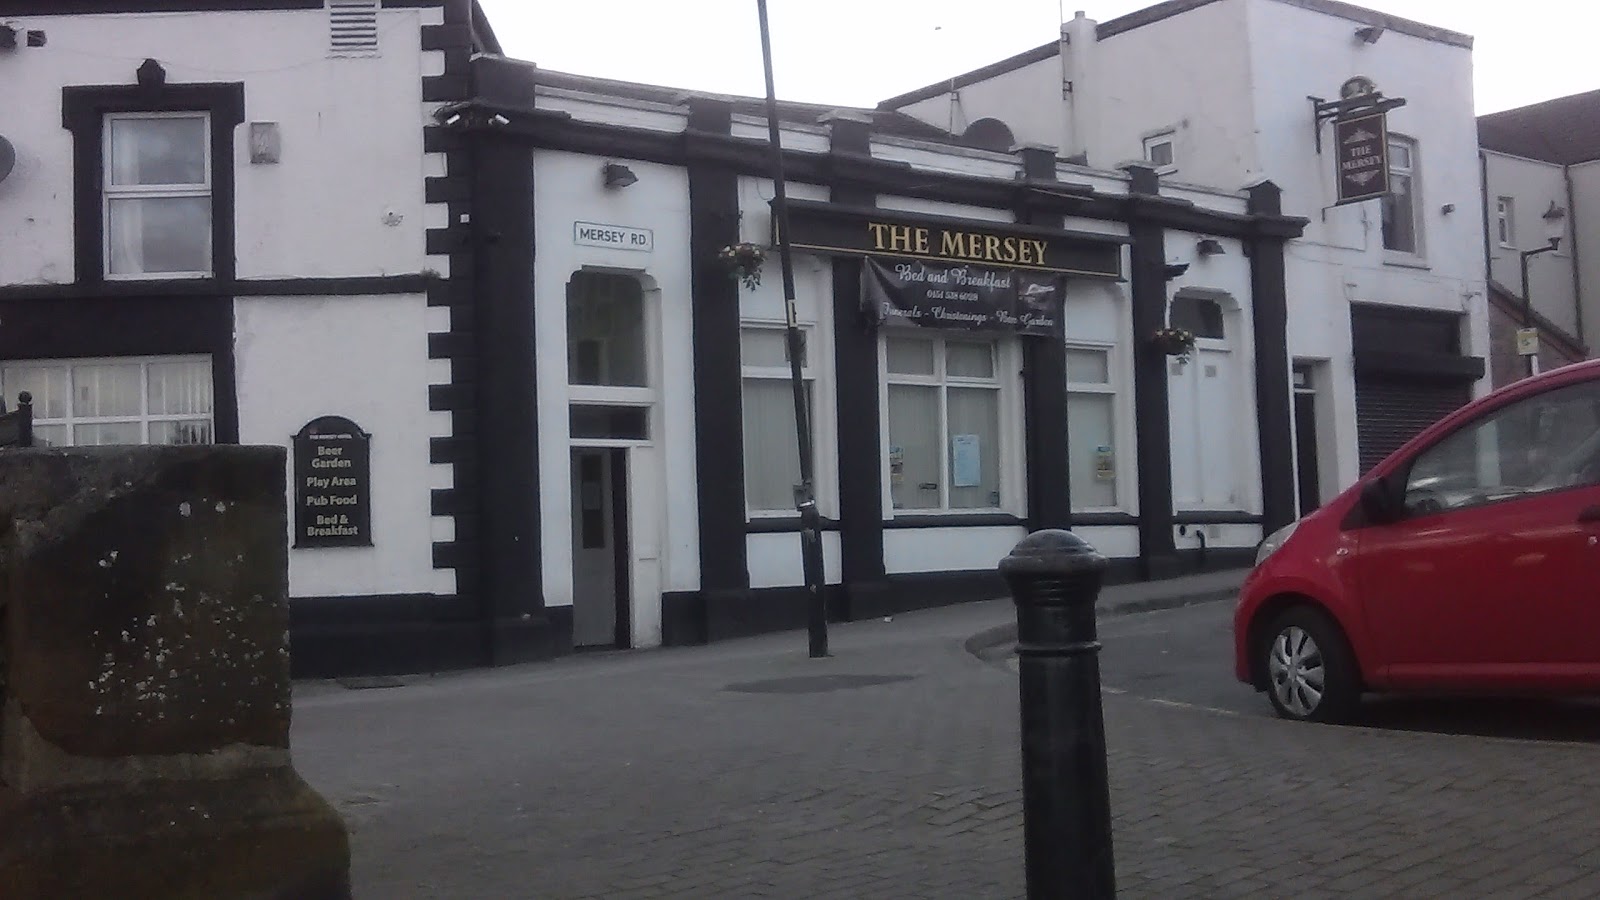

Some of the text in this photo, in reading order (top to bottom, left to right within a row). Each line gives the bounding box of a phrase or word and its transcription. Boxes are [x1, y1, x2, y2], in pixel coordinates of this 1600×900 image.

[1350, 145, 1372, 157] THE
[1342, 155, 1381, 170] MERSEY
[580, 228, 625, 243] MERSEY
[868, 222, 1048, 265] THE MERSEY
[895, 263, 1011, 292] Bed and Breakfast
[317, 446, 342, 456] Beer
[312, 458, 351, 468] Garden
[306, 477, 357, 489] Play Area
[306, 495, 357, 506] Pub Food
[316, 514, 349, 525] Bed &
[307, 526, 358, 537] Breakfast
